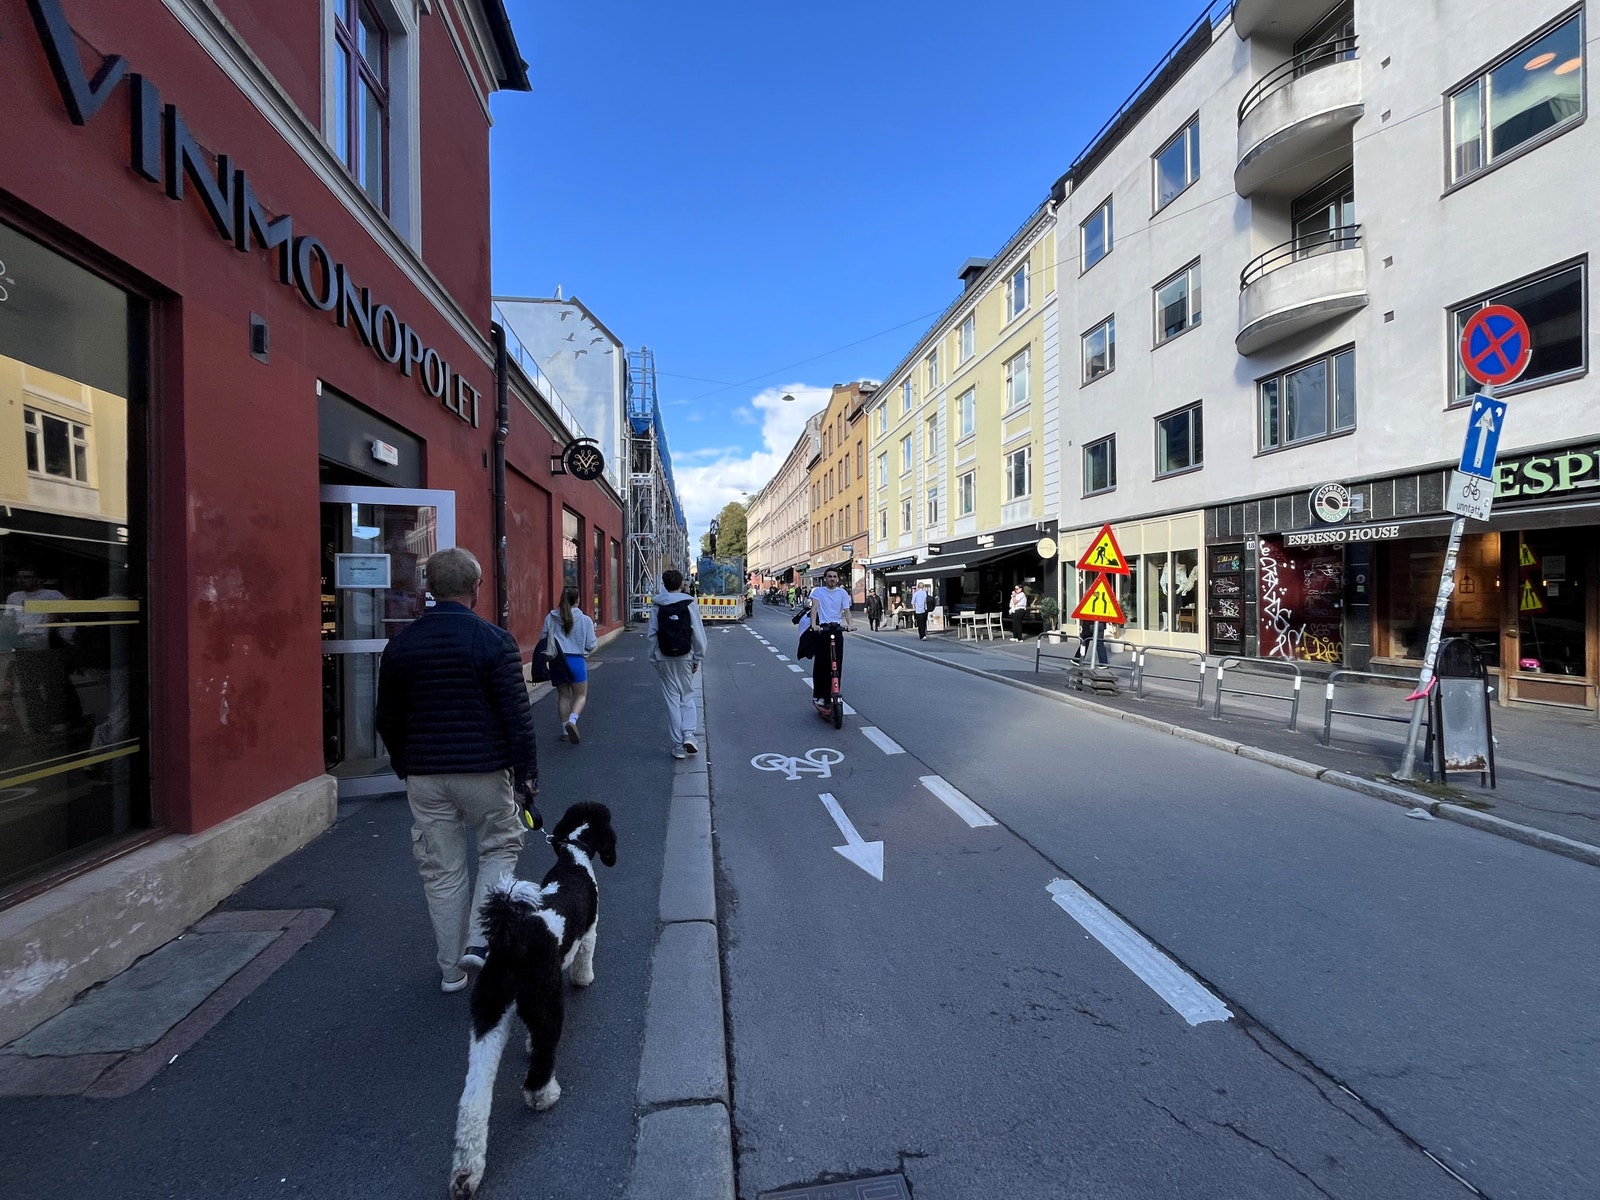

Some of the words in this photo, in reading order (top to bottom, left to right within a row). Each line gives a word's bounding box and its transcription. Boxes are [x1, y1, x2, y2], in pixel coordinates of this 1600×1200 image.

[28, 0, 482, 429] VINMONOPOLET
[1493, 450, 1600, 498] ESP
[1318, 485, 1347, 499] ESPRESSO
[1321, 511, 1344, 520] HOUSE
[1456, 502, 1481, 515] unntatt
[1287, 531, 1347, 546] ESPRESSO
[1348, 525, 1400, 541] HOUSE
